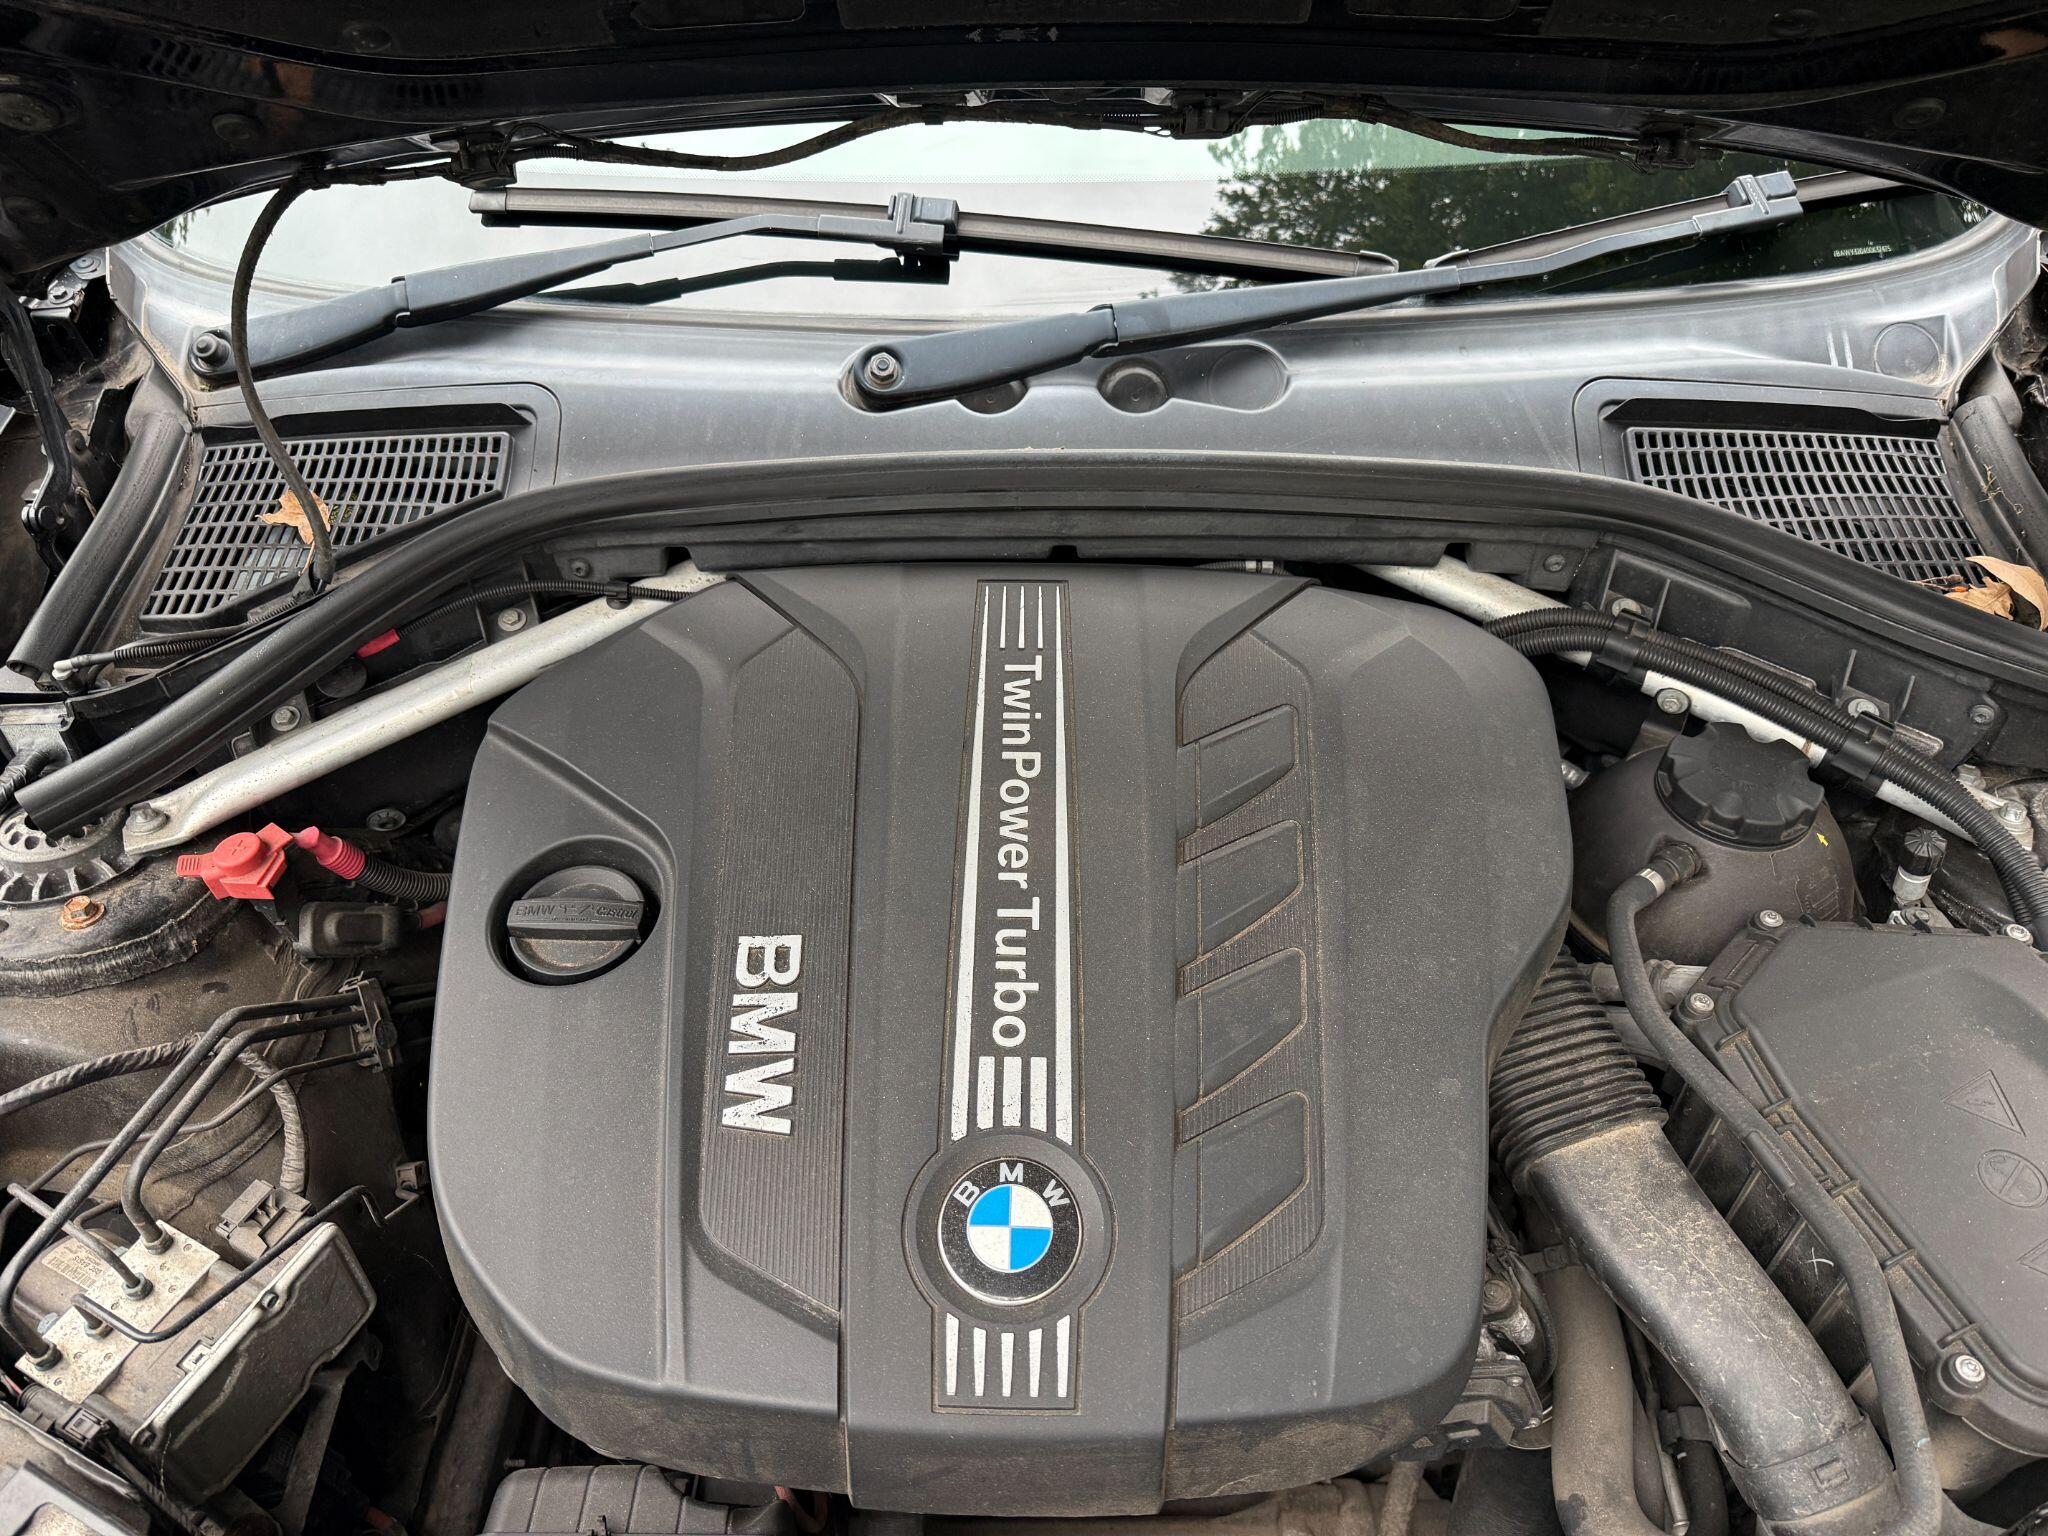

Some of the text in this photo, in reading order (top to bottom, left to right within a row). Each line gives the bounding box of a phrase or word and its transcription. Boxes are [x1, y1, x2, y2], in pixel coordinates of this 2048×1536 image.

[515, 904, 555, 917] BMW
[596, 905, 639, 919] Castrol
[992, 655, 1043, 1048] TwinPower Turbo
[721, 934, 803, 1134] BMW
[952, 1162, 1071, 1208] BMW
